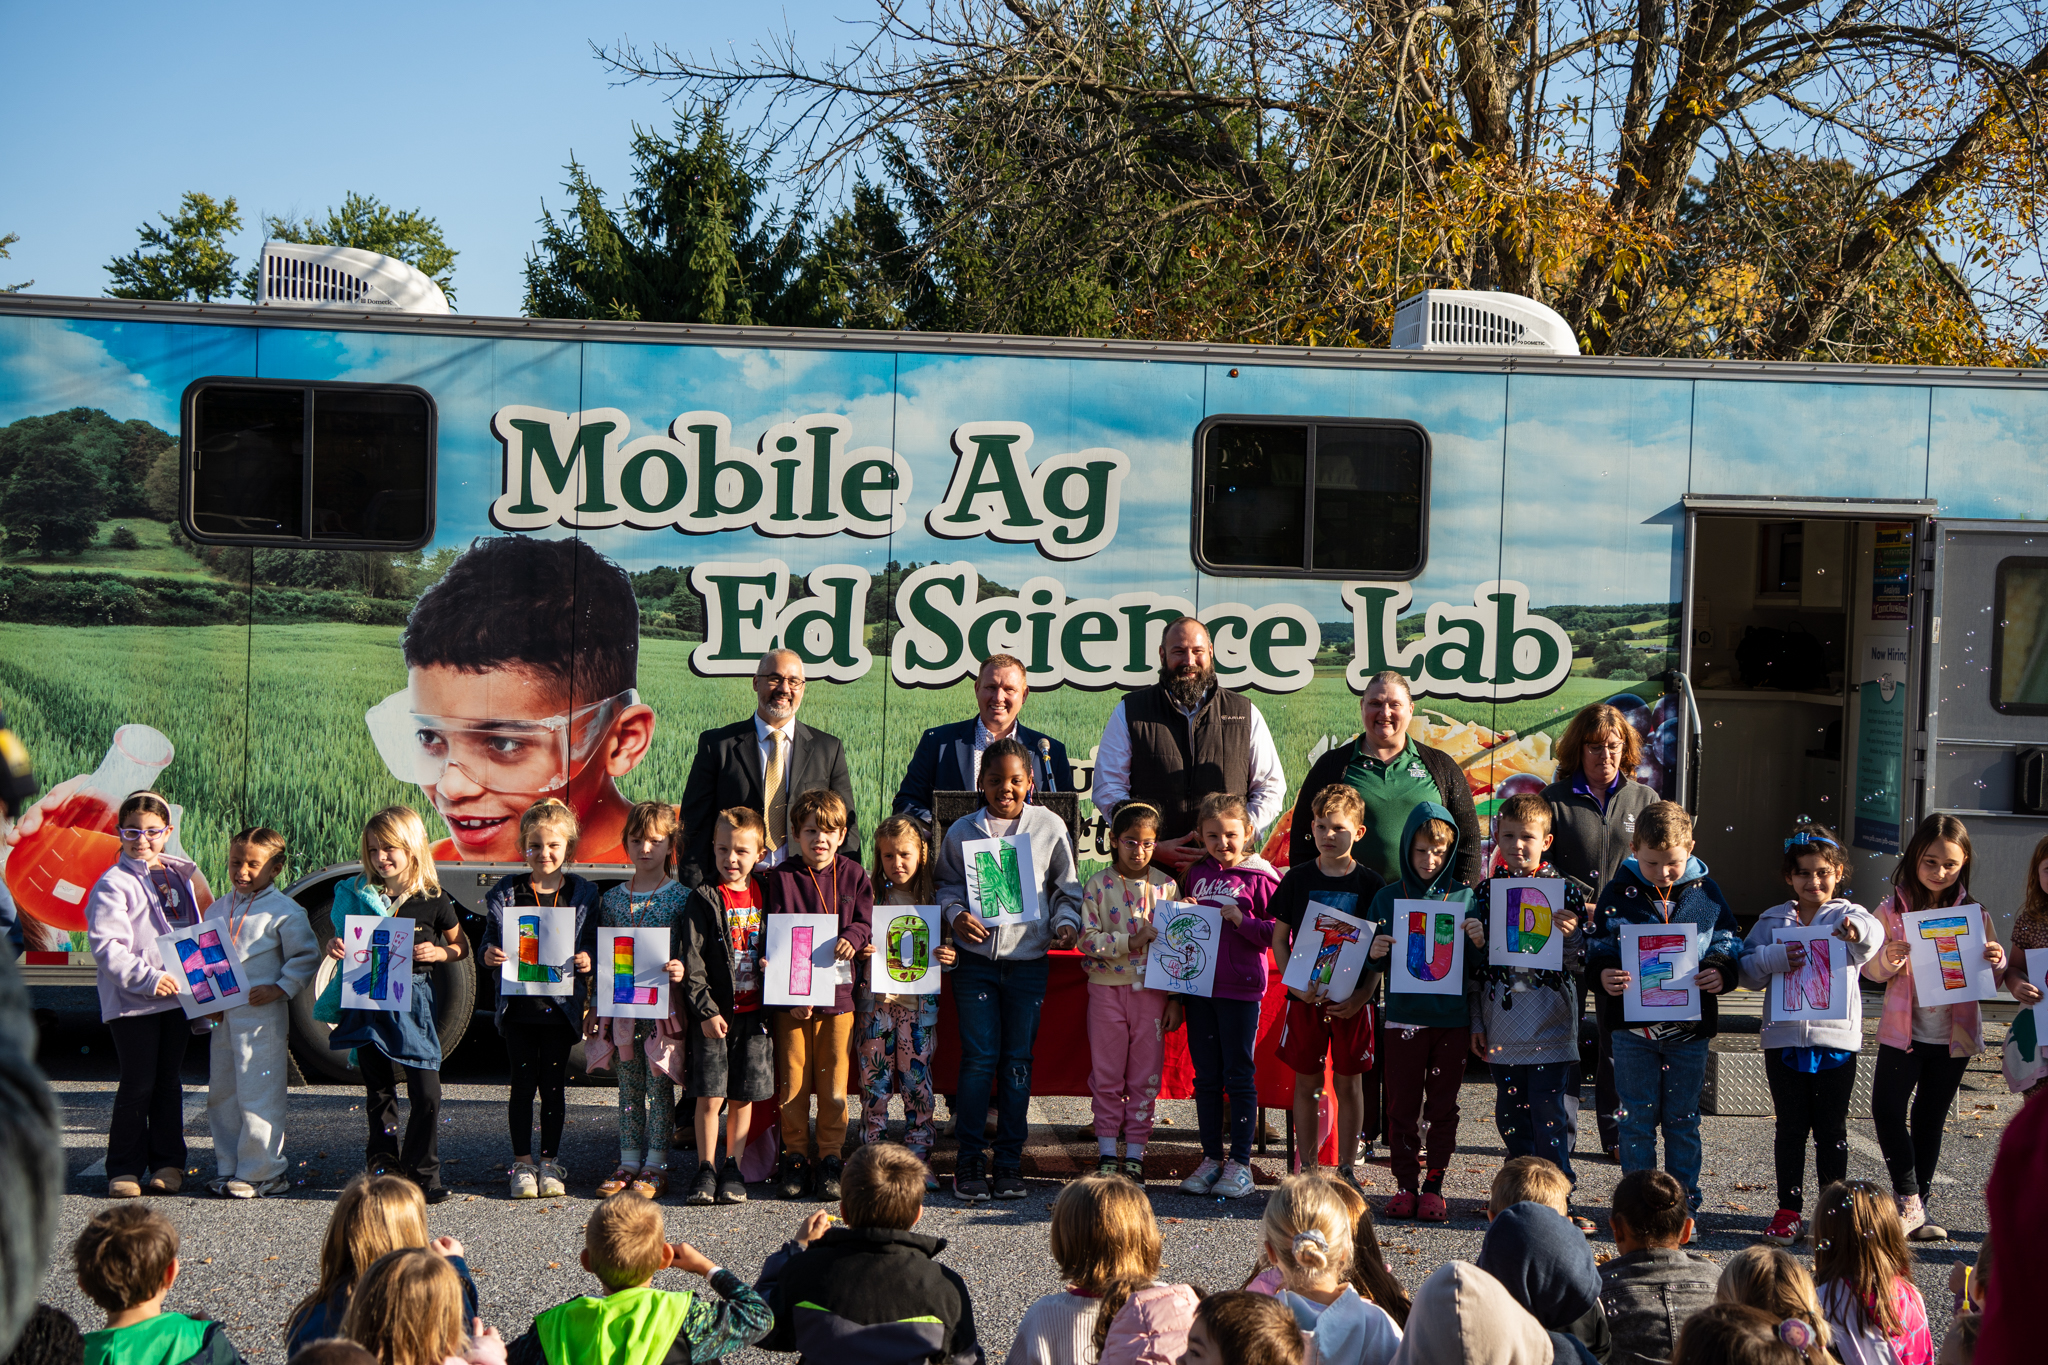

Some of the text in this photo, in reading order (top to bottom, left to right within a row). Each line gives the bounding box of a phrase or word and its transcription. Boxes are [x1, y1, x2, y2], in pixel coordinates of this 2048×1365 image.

[366, 298, 393, 306] Dometic
[1454, 299, 1480, 308] EVOLUTION
[508, 417, 1117, 545] Mobile Ag
[704, 571, 1560, 685] Ed Science Lab
[1875, 602, 1908, 615] Conclusion
[1871, 646, 1886, 660] Now
[975, 849, 1024, 918] N
[1192, 878, 1246, 899] OshKosh
[518, 916, 563, 983] L
[1160, 912, 1211, 980] S
[1309, 913, 1362, 985] T
[1407, 911, 1455, 982] U
[1506, 887, 1553, 953] D
[1918, 916, 1970, 990] T
[175, 929, 241, 1003] M
[612, 936, 659, 1004] L
[1638, 935, 1689, 1007] E
[1783, 939, 1832, 1012] N
